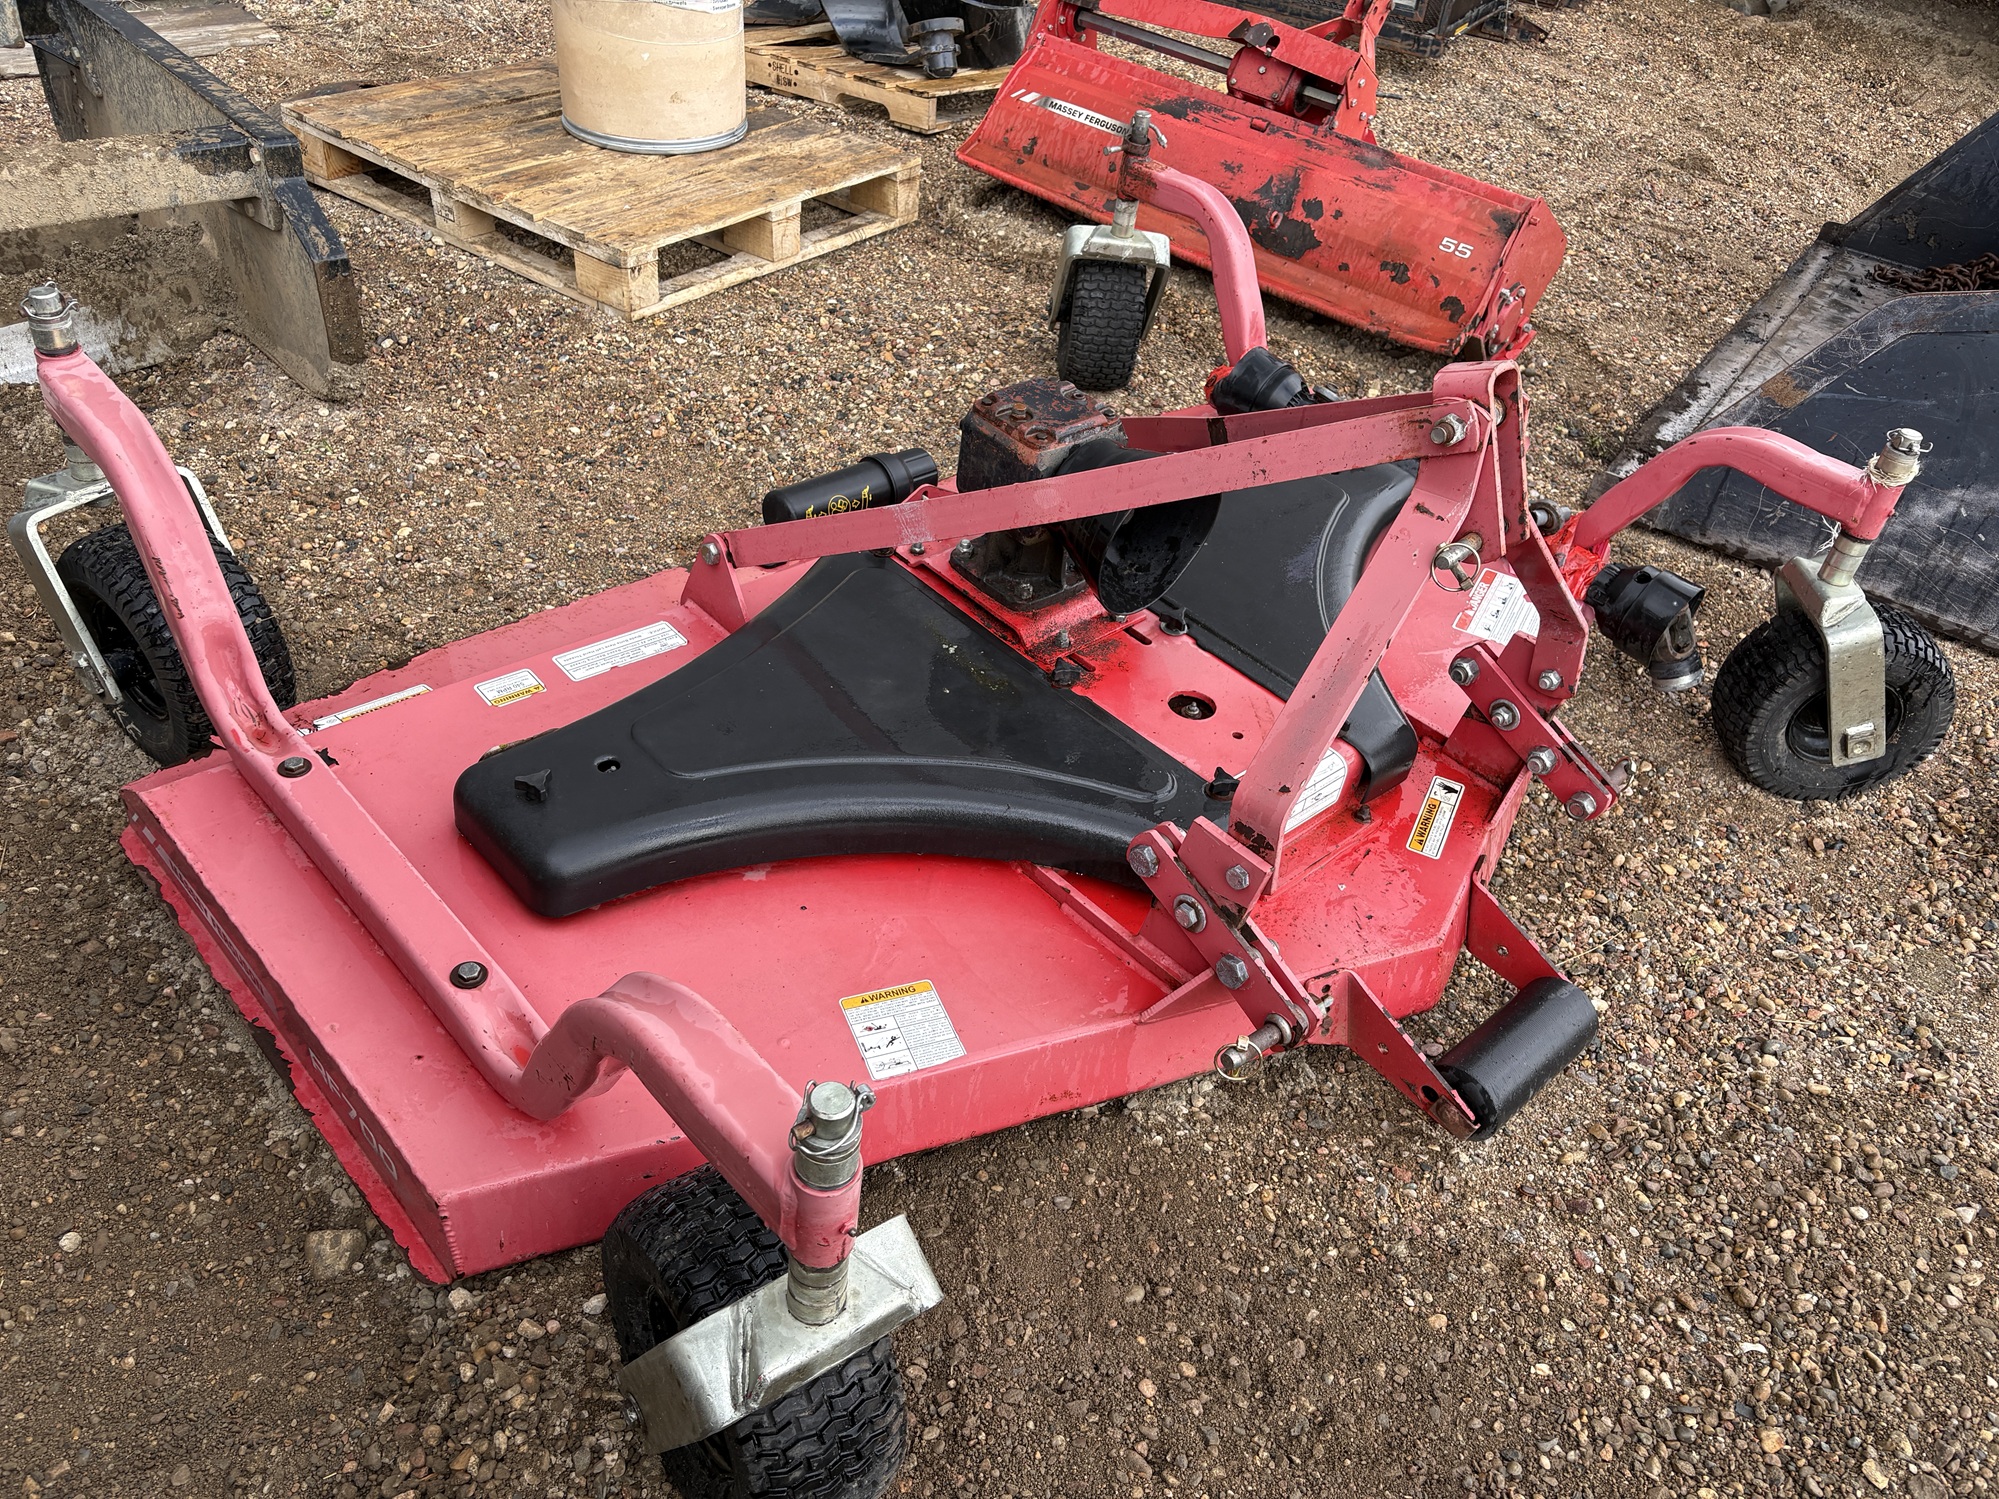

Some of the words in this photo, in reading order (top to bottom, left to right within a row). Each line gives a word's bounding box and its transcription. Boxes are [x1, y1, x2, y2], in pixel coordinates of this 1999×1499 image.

[772, 61, 793, 76] SHELL
[1048, 101, 1084, 119] MASSEY
[1084, 114, 1129, 135] FERGUSON
[1438, 236, 1474, 259] 55
[494, 689, 533, 704] WARNING
[1416, 803, 1437, 838] WARNING
[868, 985, 916, 1001] WARNING
